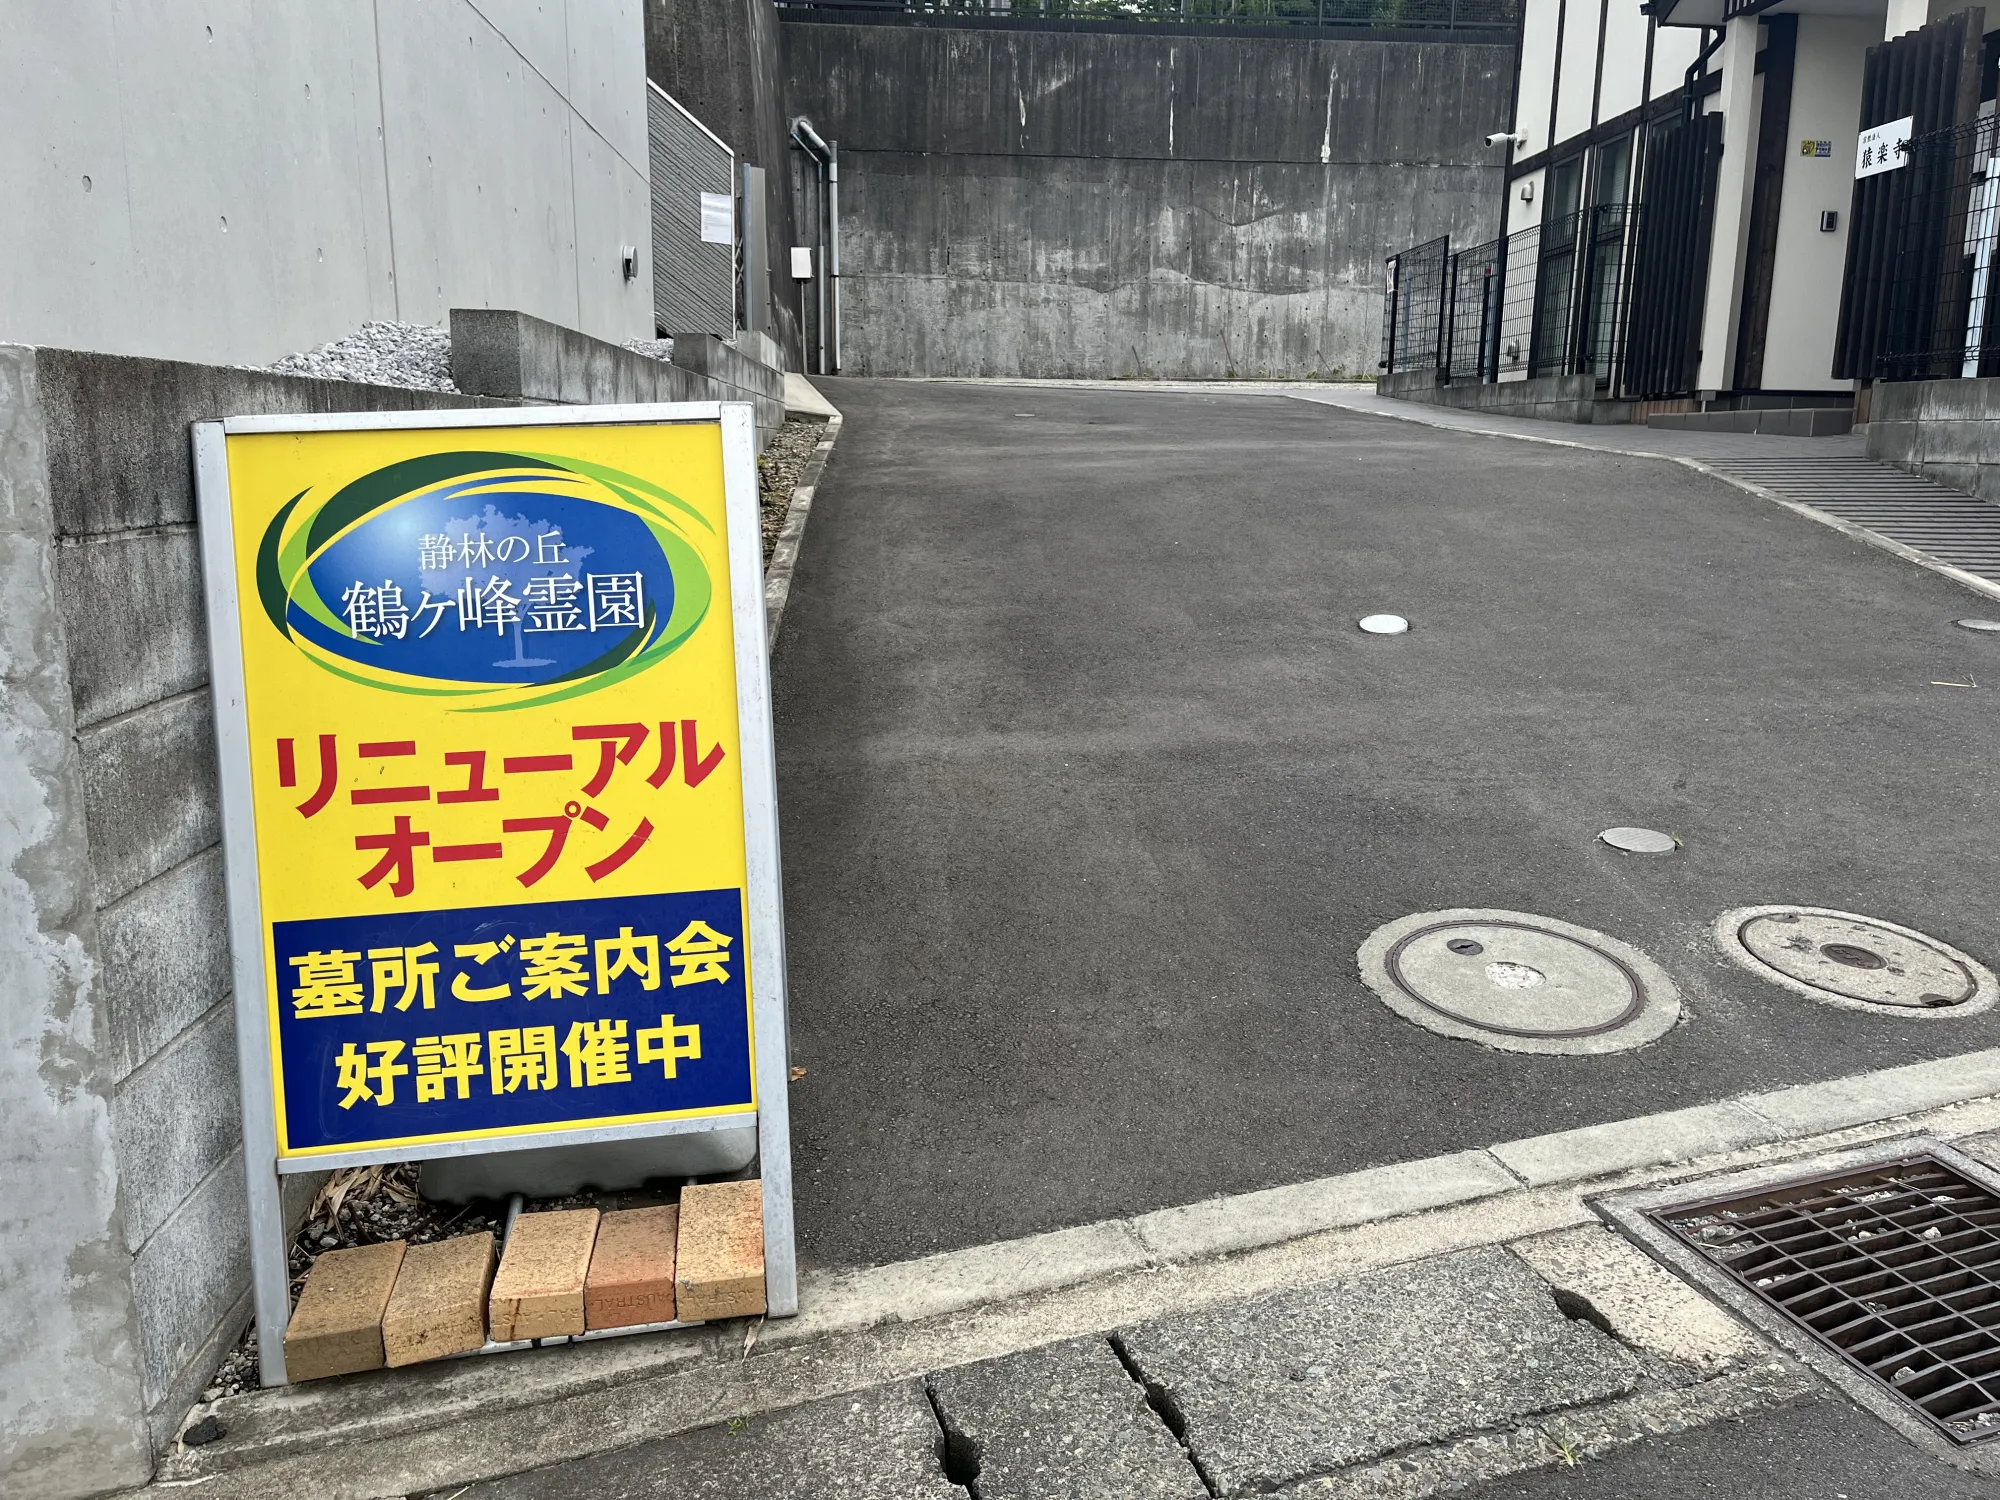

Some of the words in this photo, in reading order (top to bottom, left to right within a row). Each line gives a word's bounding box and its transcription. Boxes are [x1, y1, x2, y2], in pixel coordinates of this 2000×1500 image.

[417, 529, 570, 572] 静林の丘
[276, 718, 726, 820] リニューアル
[354, 800, 655, 898] オープン
[288, 920, 734, 1020] 墓所ご案内会
[335, 1014, 702, 1110] 好評開催中
[595, 1291, 666, 1312] AUSTRAL
